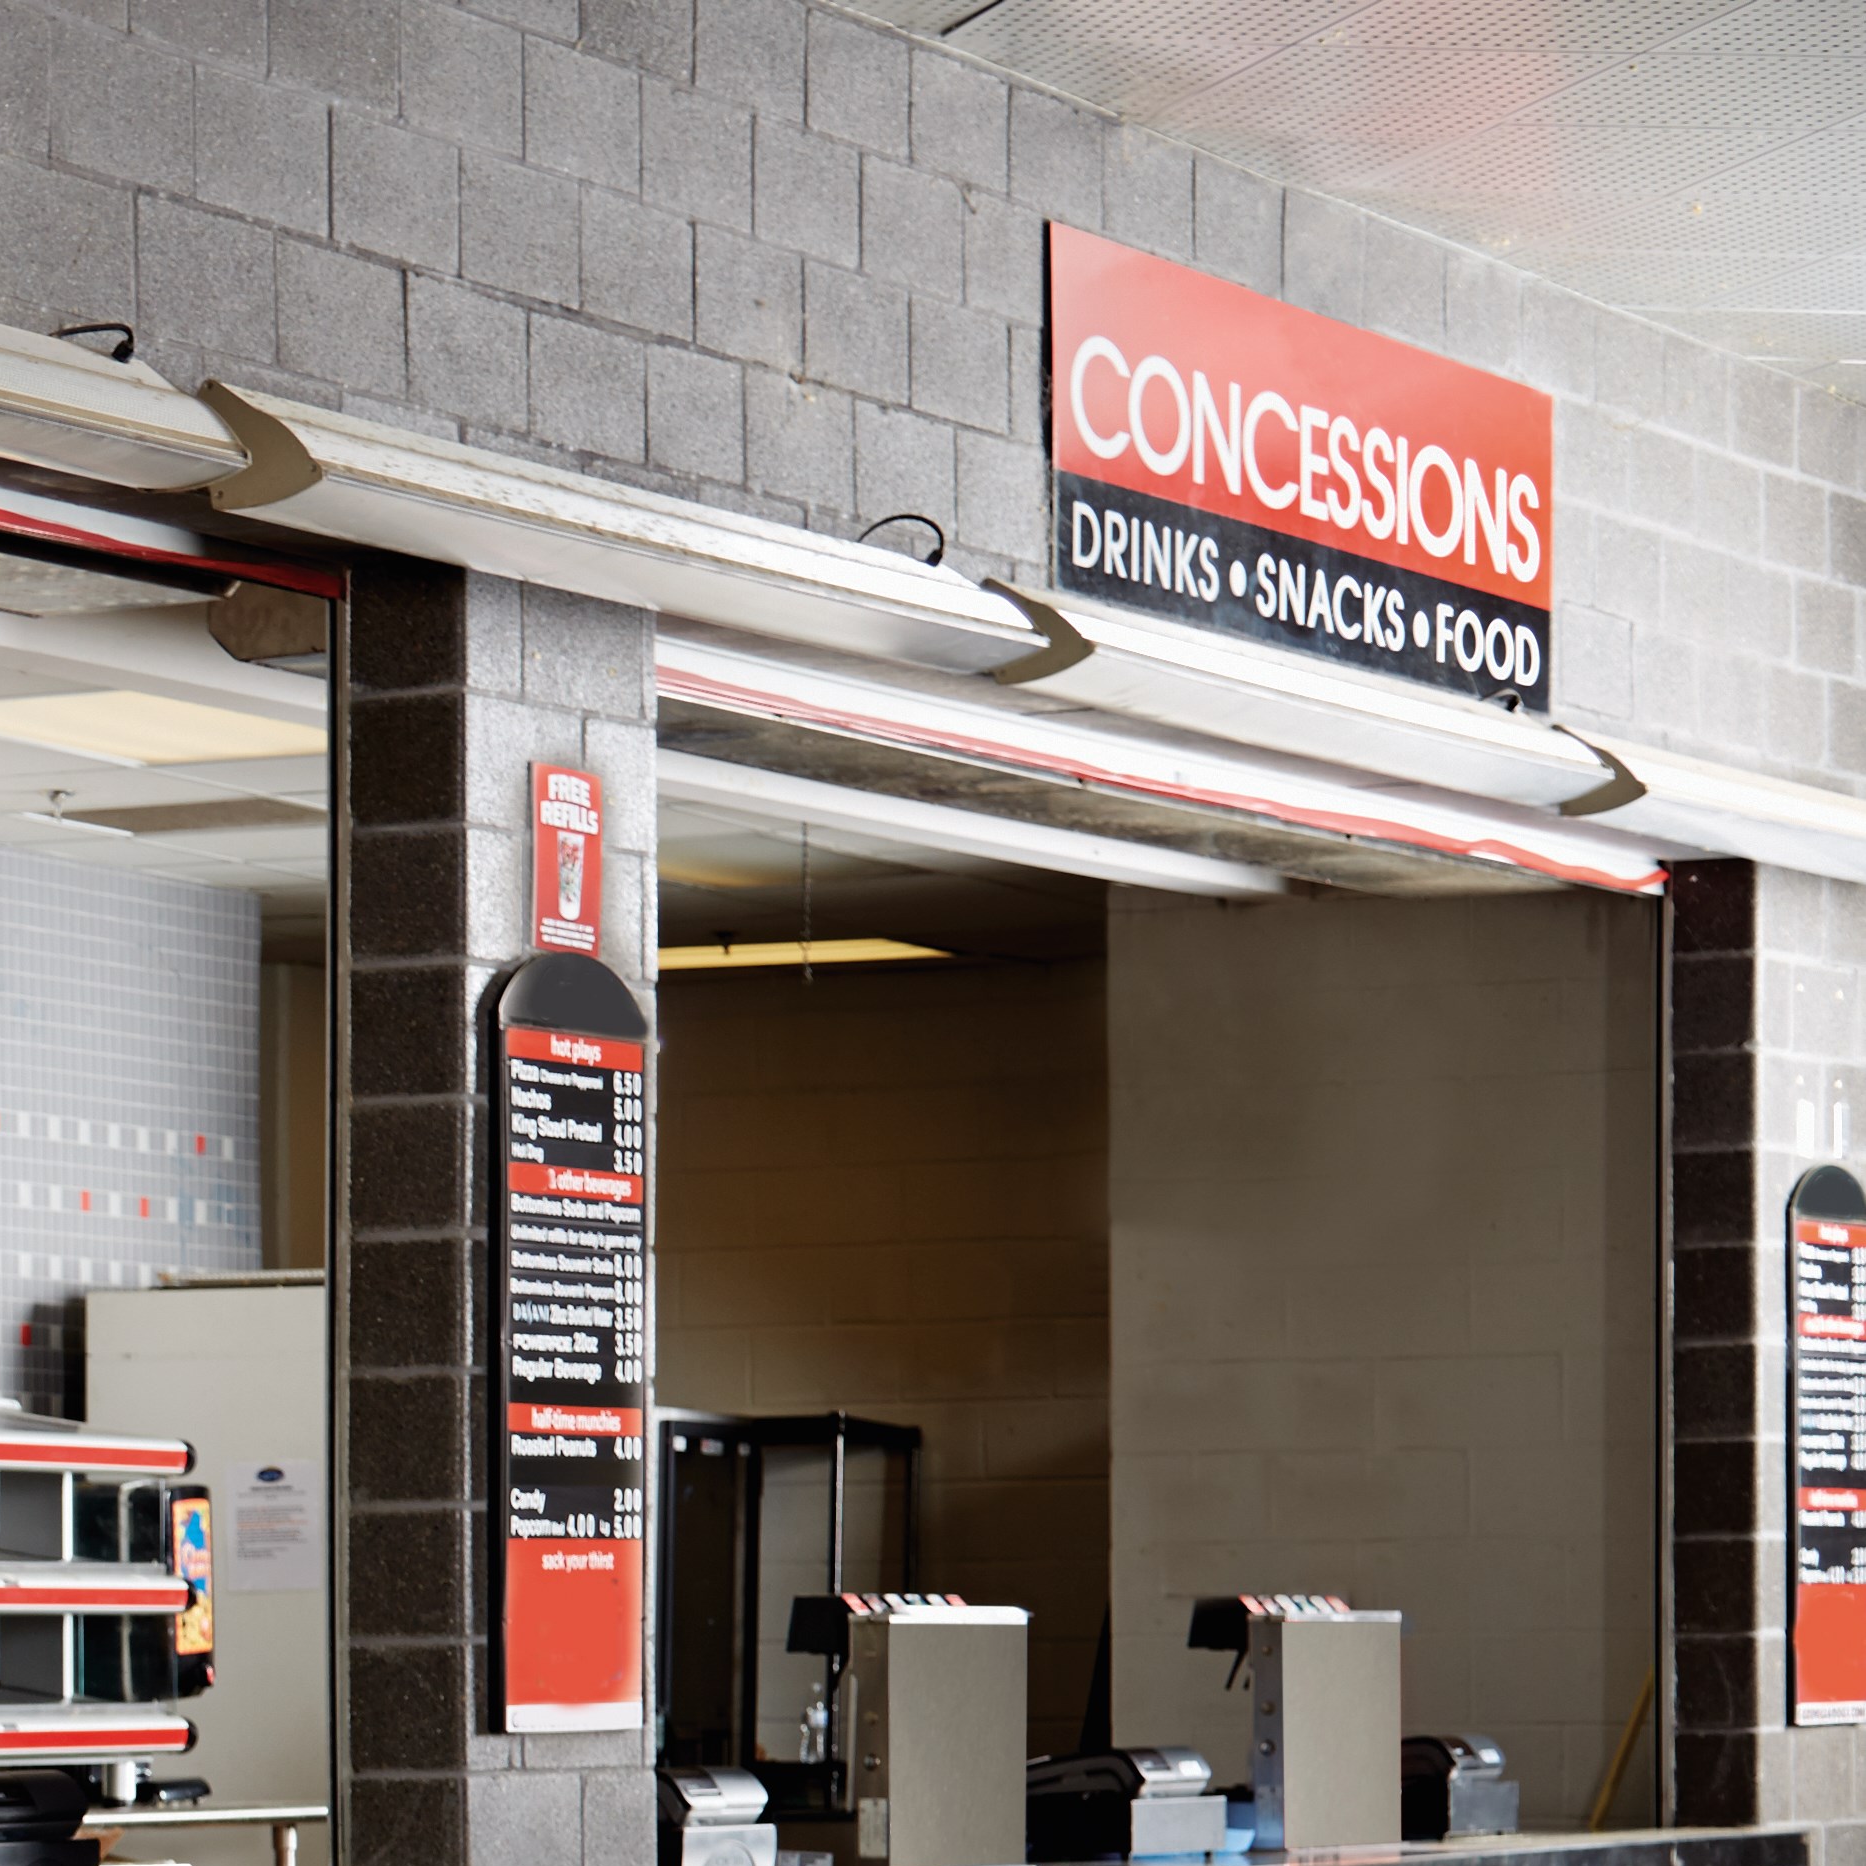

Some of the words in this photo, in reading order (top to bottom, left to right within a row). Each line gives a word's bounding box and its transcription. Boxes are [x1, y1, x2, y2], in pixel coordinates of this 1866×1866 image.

[1071, 335, 1540, 583] CONCESSIONS
[1072, 501, 1221, 602] DRINKS
[1255, 552, 1405, 652] SNACKS
[1435, 602, 1540, 687] FOOD
[547, 774, 590, 808] FREE
[540, 800, 599, 835] REFILLS
[550, 1034, 571, 1059] hot
[572, 1038, 601, 1066] plays
[511, 1058, 539, 1082] Pizza
[613, 1071, 641, 1096] 6.50
[511, 1086, 551, 1111] Nachos
[614, 1097, 642, 1123] 5.00
[511, 1113, 537, 1140] King
[614, 1150, 642, 1175] 3.50
[557, 1169, 584, 1192] other
[584, 1171, 631, 1201] beverages
[562, 1198, 586, 1218] Soda
[513, 1355, 554, 1382] Regular
[554, 1357, 602, 1384] Beverage
[576, 1410, 621, 1432] munchies
[511, 1434, 555, 1456] Roasted
[556, 1436, 597, 1458] Peanuts
[614, 1437, 642, 1460] 4.00
[511, 1488, 546, 1514] Candy
[614, 1488, 642, 1512] 2.00
[565, 1554, 587, 1573] your
